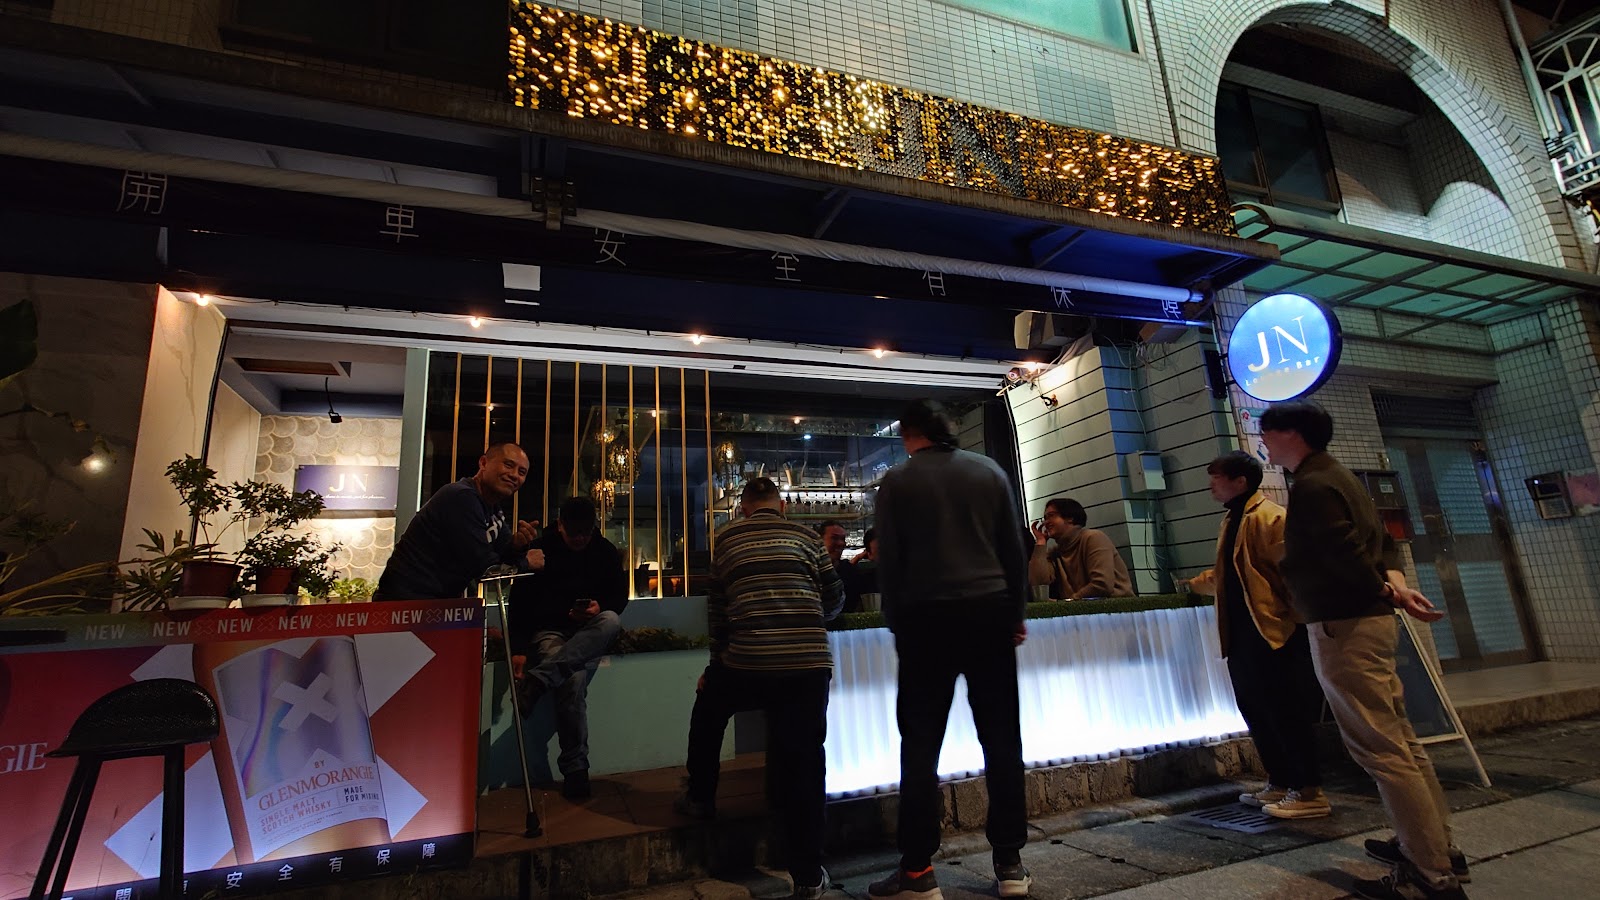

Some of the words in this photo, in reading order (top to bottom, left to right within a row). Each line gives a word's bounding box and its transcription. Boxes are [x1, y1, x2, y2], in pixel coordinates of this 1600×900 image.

[1247, 315, 1309, 373] JN
[329, 473, 369, 493] JN
[85, 624, 126, 641] NEW
[152, 620, 192, 637] NEW
[217, 617, 254, 634] NEW
[278, 614, 313, 631] NEW
[336, 612, 370, 628] NEW
[391, 609, 423, 625] NEW
[444, 607, 475, 622] NEW
[314, 759, 325, 769] BY
[258, 765, 375, 811] GLENMORANGIE
[344, 785, 363, 795] MADE
[345, 794, 359, 803] FOR
[261, 807, 289, 827] SINGLE
[293, 797, 316, 811] MALT
[262, 813, 294, 835] SCOTCH
[297, 800, 331, 818] WHISKY
